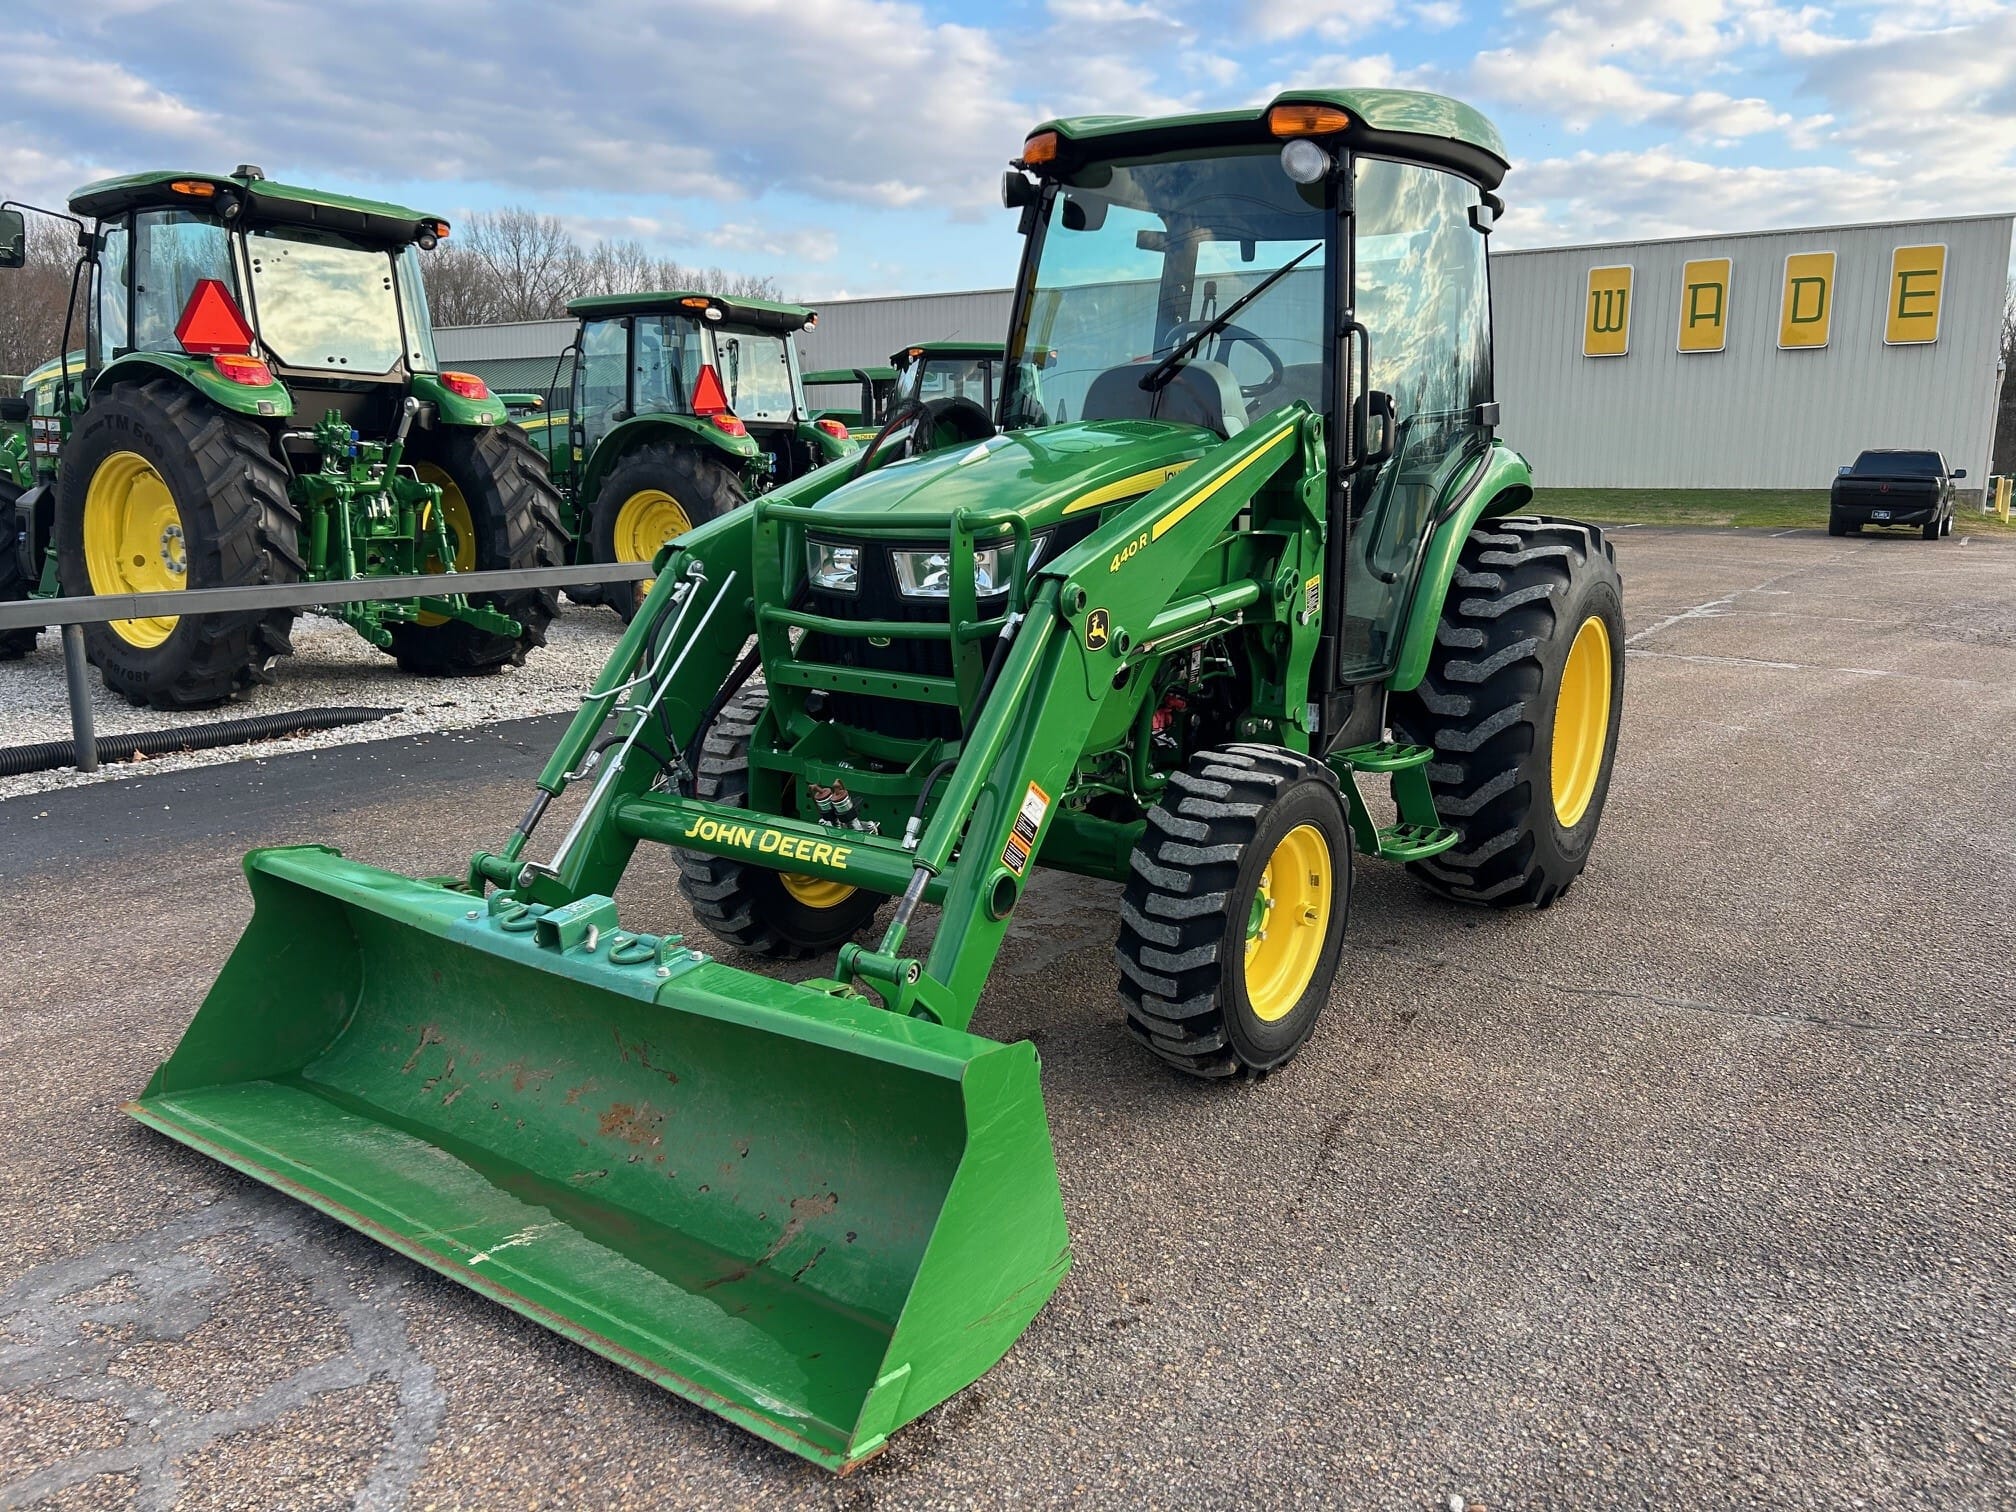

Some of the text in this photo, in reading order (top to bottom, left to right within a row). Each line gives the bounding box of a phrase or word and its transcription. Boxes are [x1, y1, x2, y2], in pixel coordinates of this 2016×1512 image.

[1591, 269, 1938, 333] WADE
[685, 816, 852, 869] JOHN DEERE
